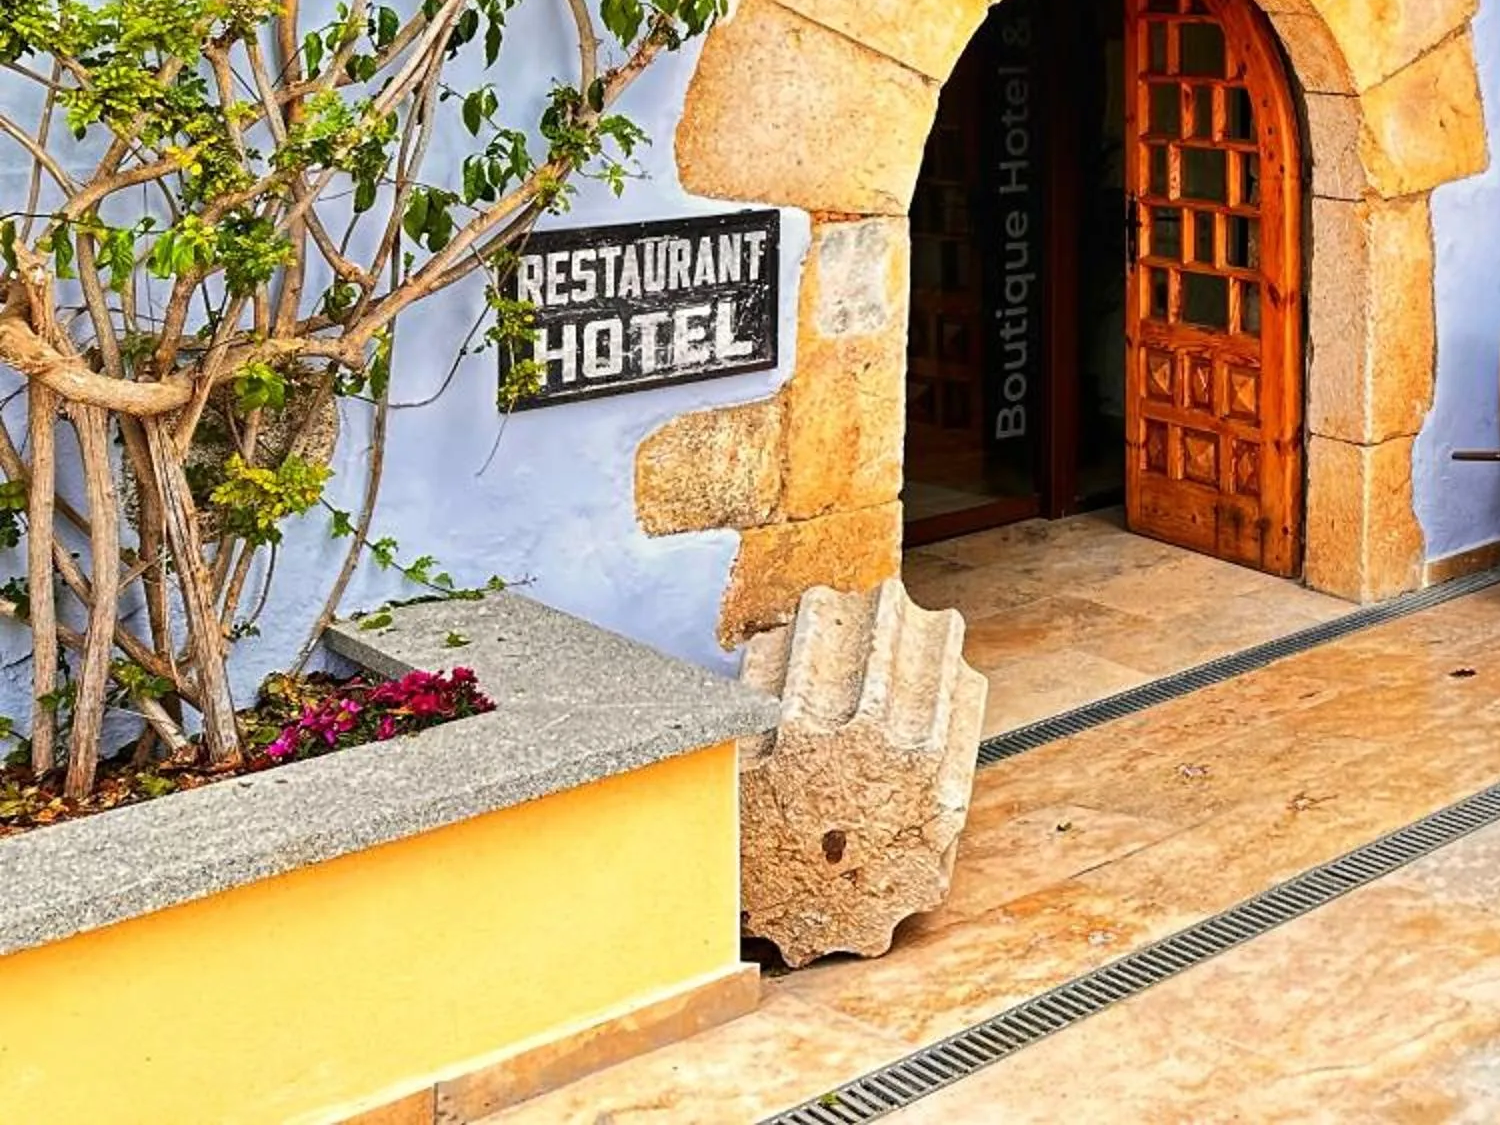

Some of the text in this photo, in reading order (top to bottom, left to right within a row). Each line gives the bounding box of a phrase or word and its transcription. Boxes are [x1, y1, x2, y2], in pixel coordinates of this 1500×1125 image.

[517, 231, 767, 308] RESTAURANT
[995, 17, 1036, 441] Boutique Hotel &
[533, 299, 753, 387] HOTEL
